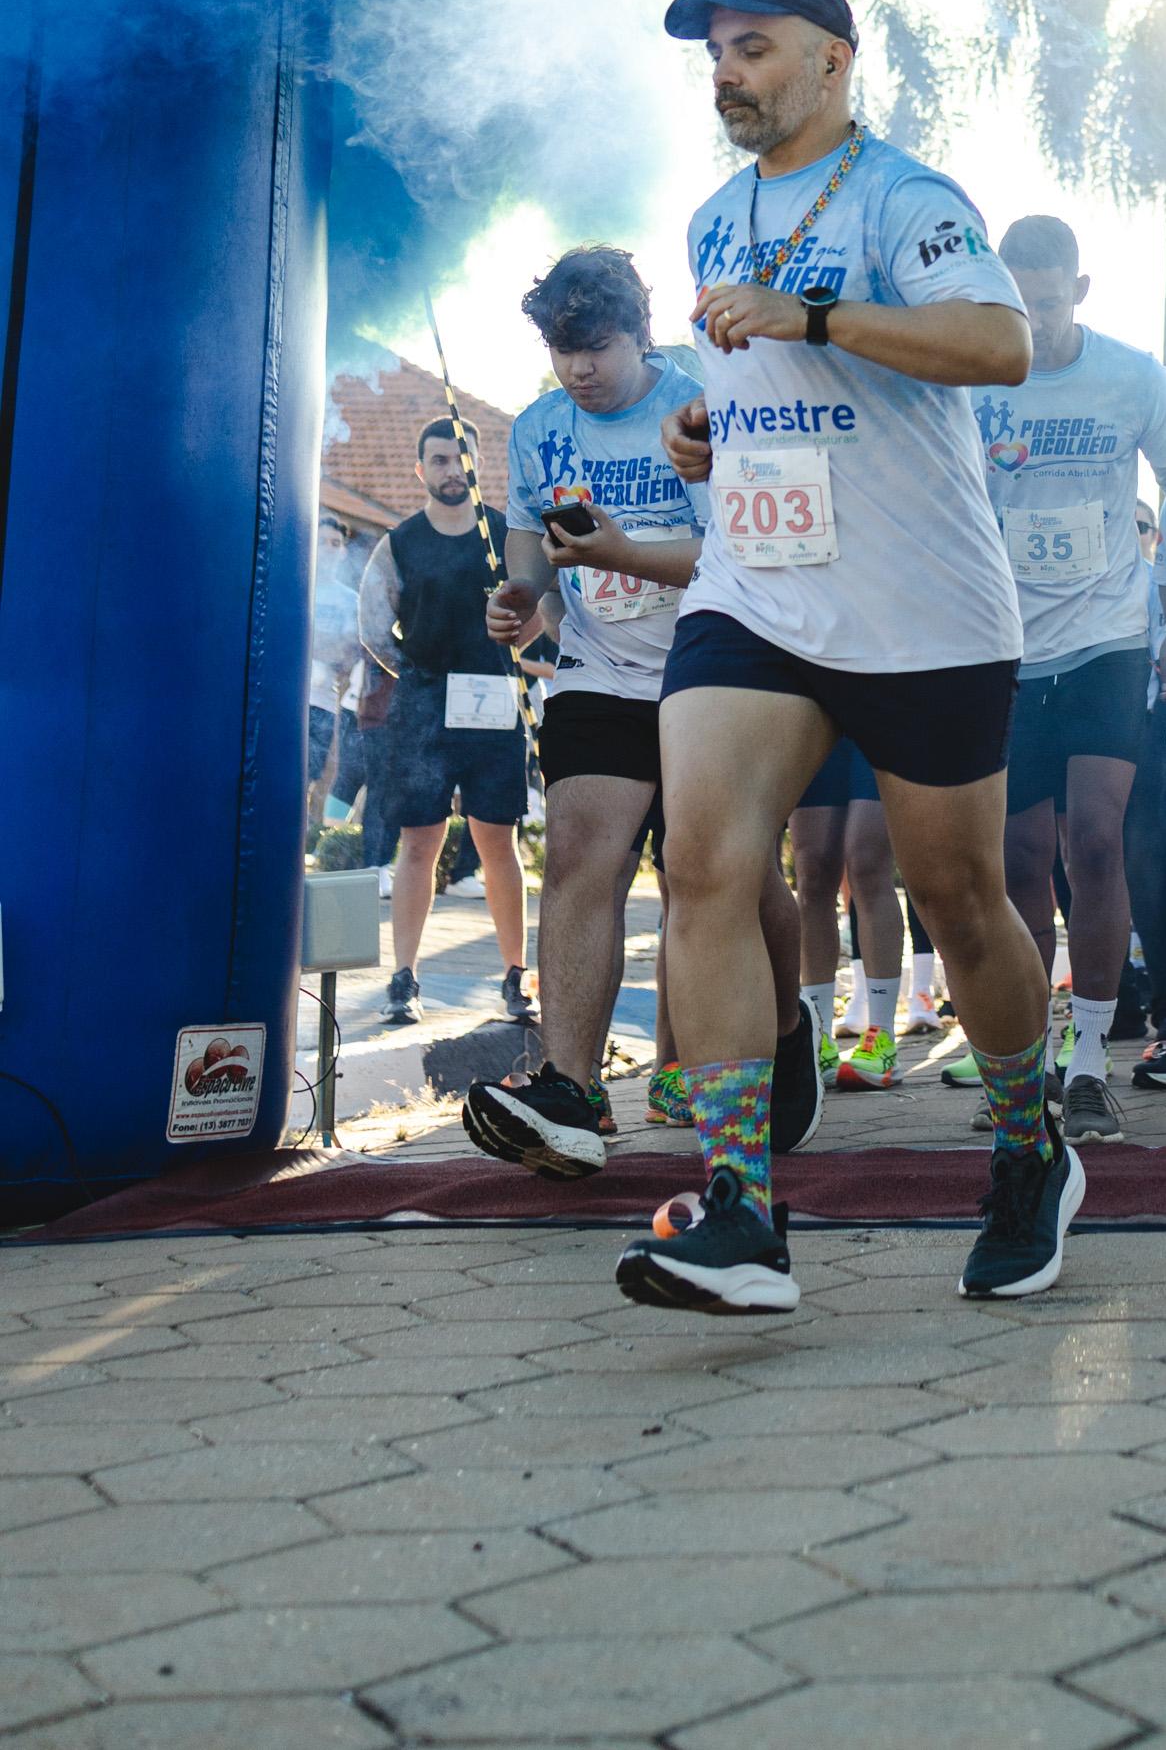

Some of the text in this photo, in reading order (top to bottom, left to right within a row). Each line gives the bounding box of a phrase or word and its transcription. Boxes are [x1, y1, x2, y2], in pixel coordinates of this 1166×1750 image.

[709, 400, 856, 443] sylvestre
[1020, 418, 1095, 438] PASSOS
[1029, 436, 1117, 457] ACOLHEM
[581, 457, 652, 483] PASSOS
[1033, 470, 1065, 479] Corrida
[1067, 469, 1089, 478] Abril
[591, 478, 684, 507] ACOLHEM
[726, 490, 814, 535] 203
[1027, 533, 1072, 561] 35
[593, 569, 668, 600] 20
[473, 693, 487, 714] 7
